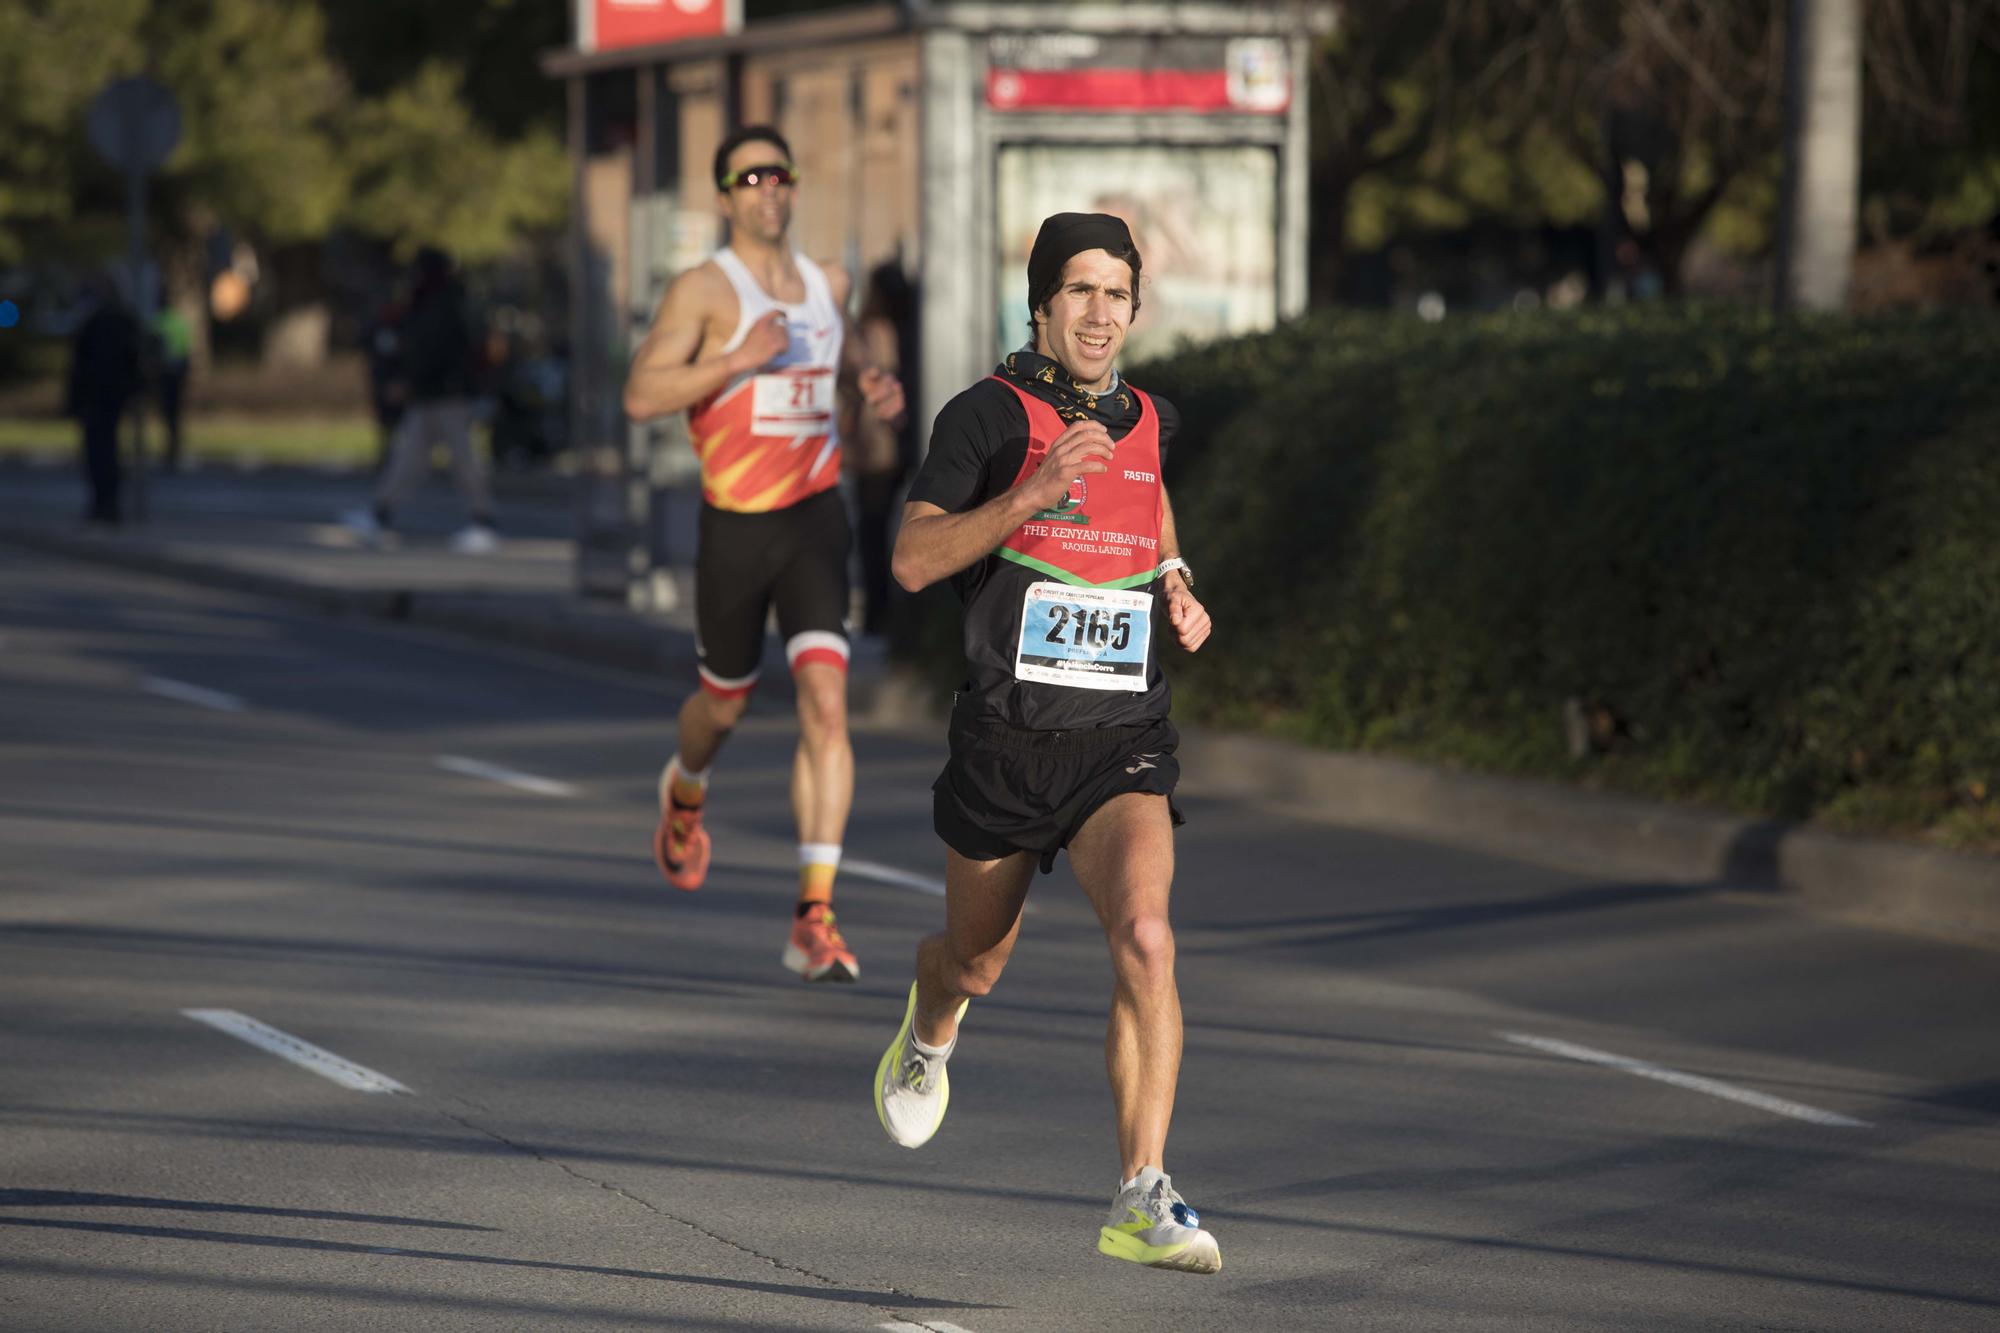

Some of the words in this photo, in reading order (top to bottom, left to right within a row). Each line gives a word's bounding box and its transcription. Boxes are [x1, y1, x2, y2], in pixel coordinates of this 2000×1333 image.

[1124, 470, 1155, 483] FASTER
[1023, 525, 1048, 537] THE
[1051, 527, 1099, 541] KENYAN
[1102, 531, 1138, 545] URBAN
[1138, 536, 1157, 549] WAY
[1062, 541, 1097, 553] RAQUEL
[1099, 545, 1132, 556] LANDIN
[1046, 605, 1131, 650] 2165
